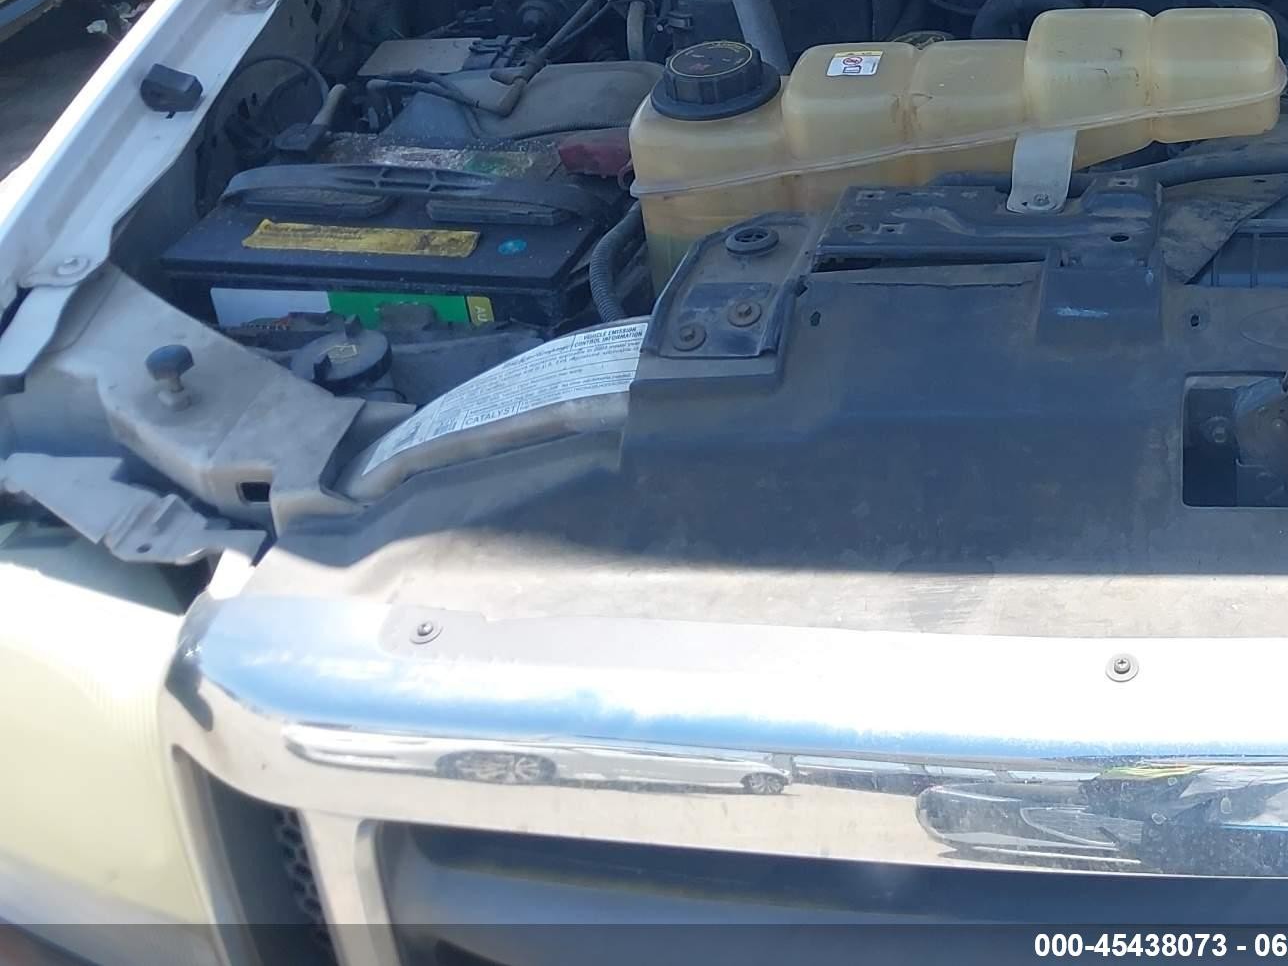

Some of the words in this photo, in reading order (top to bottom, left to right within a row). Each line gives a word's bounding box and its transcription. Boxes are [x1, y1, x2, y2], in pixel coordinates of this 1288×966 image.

[574, 338, 601, 348] CONTROL
[602, 331, 643, 342] INFORMATION
[584, 330, 607, 340] VEHICLE
[608, 327, 637, 336] EMISSION
